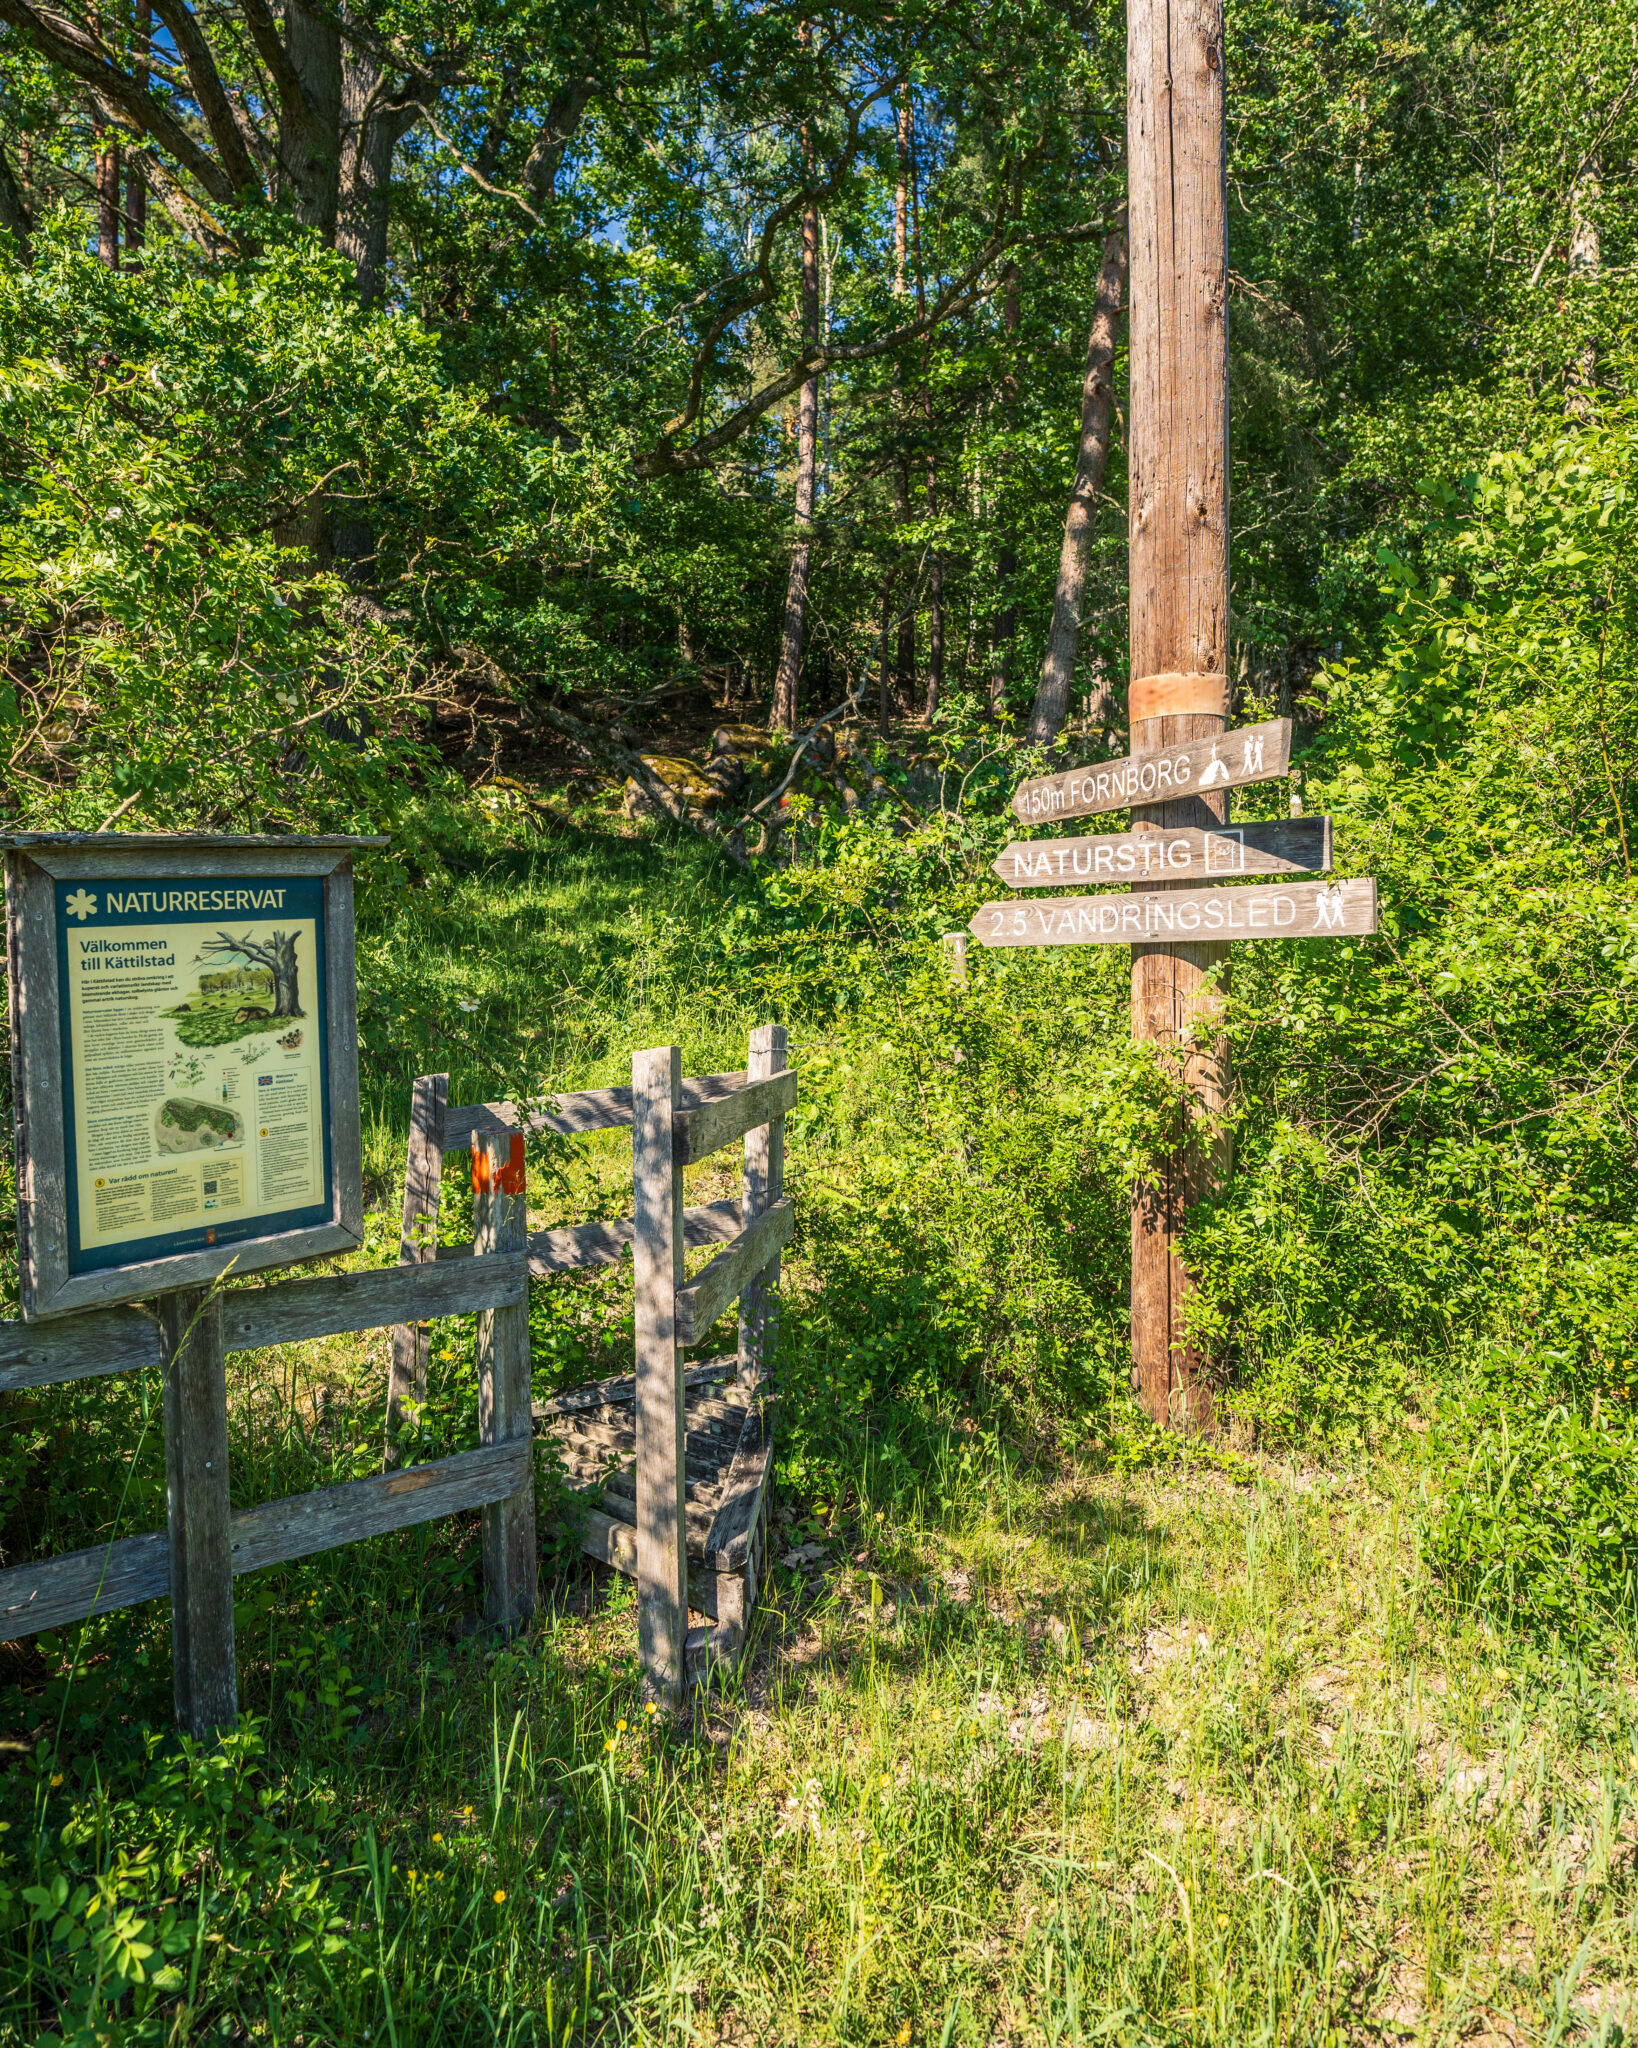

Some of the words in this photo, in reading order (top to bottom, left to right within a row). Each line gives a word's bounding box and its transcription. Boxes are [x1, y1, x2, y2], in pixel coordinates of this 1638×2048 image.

[1023, 786, 1065, 815] 150m
[1069, 755, 1191, 807] FORNBORG
[1013, 839, 1192, 878] NATURSTIG
[106, 889, 287, 914] NATURRESERVAT
[989, 910, 1028, 937] 2.5
[1038, 897, 1297, 935] VANDRINGSLED
[79, 939, 168, 954] Välkommen
[80, 957, 101, 971] till
[104, 953, 175, 970] Kättilstad
[121, 1174, 137, 1182] rädd
[150, 1168, 178, 1178] naturen!
